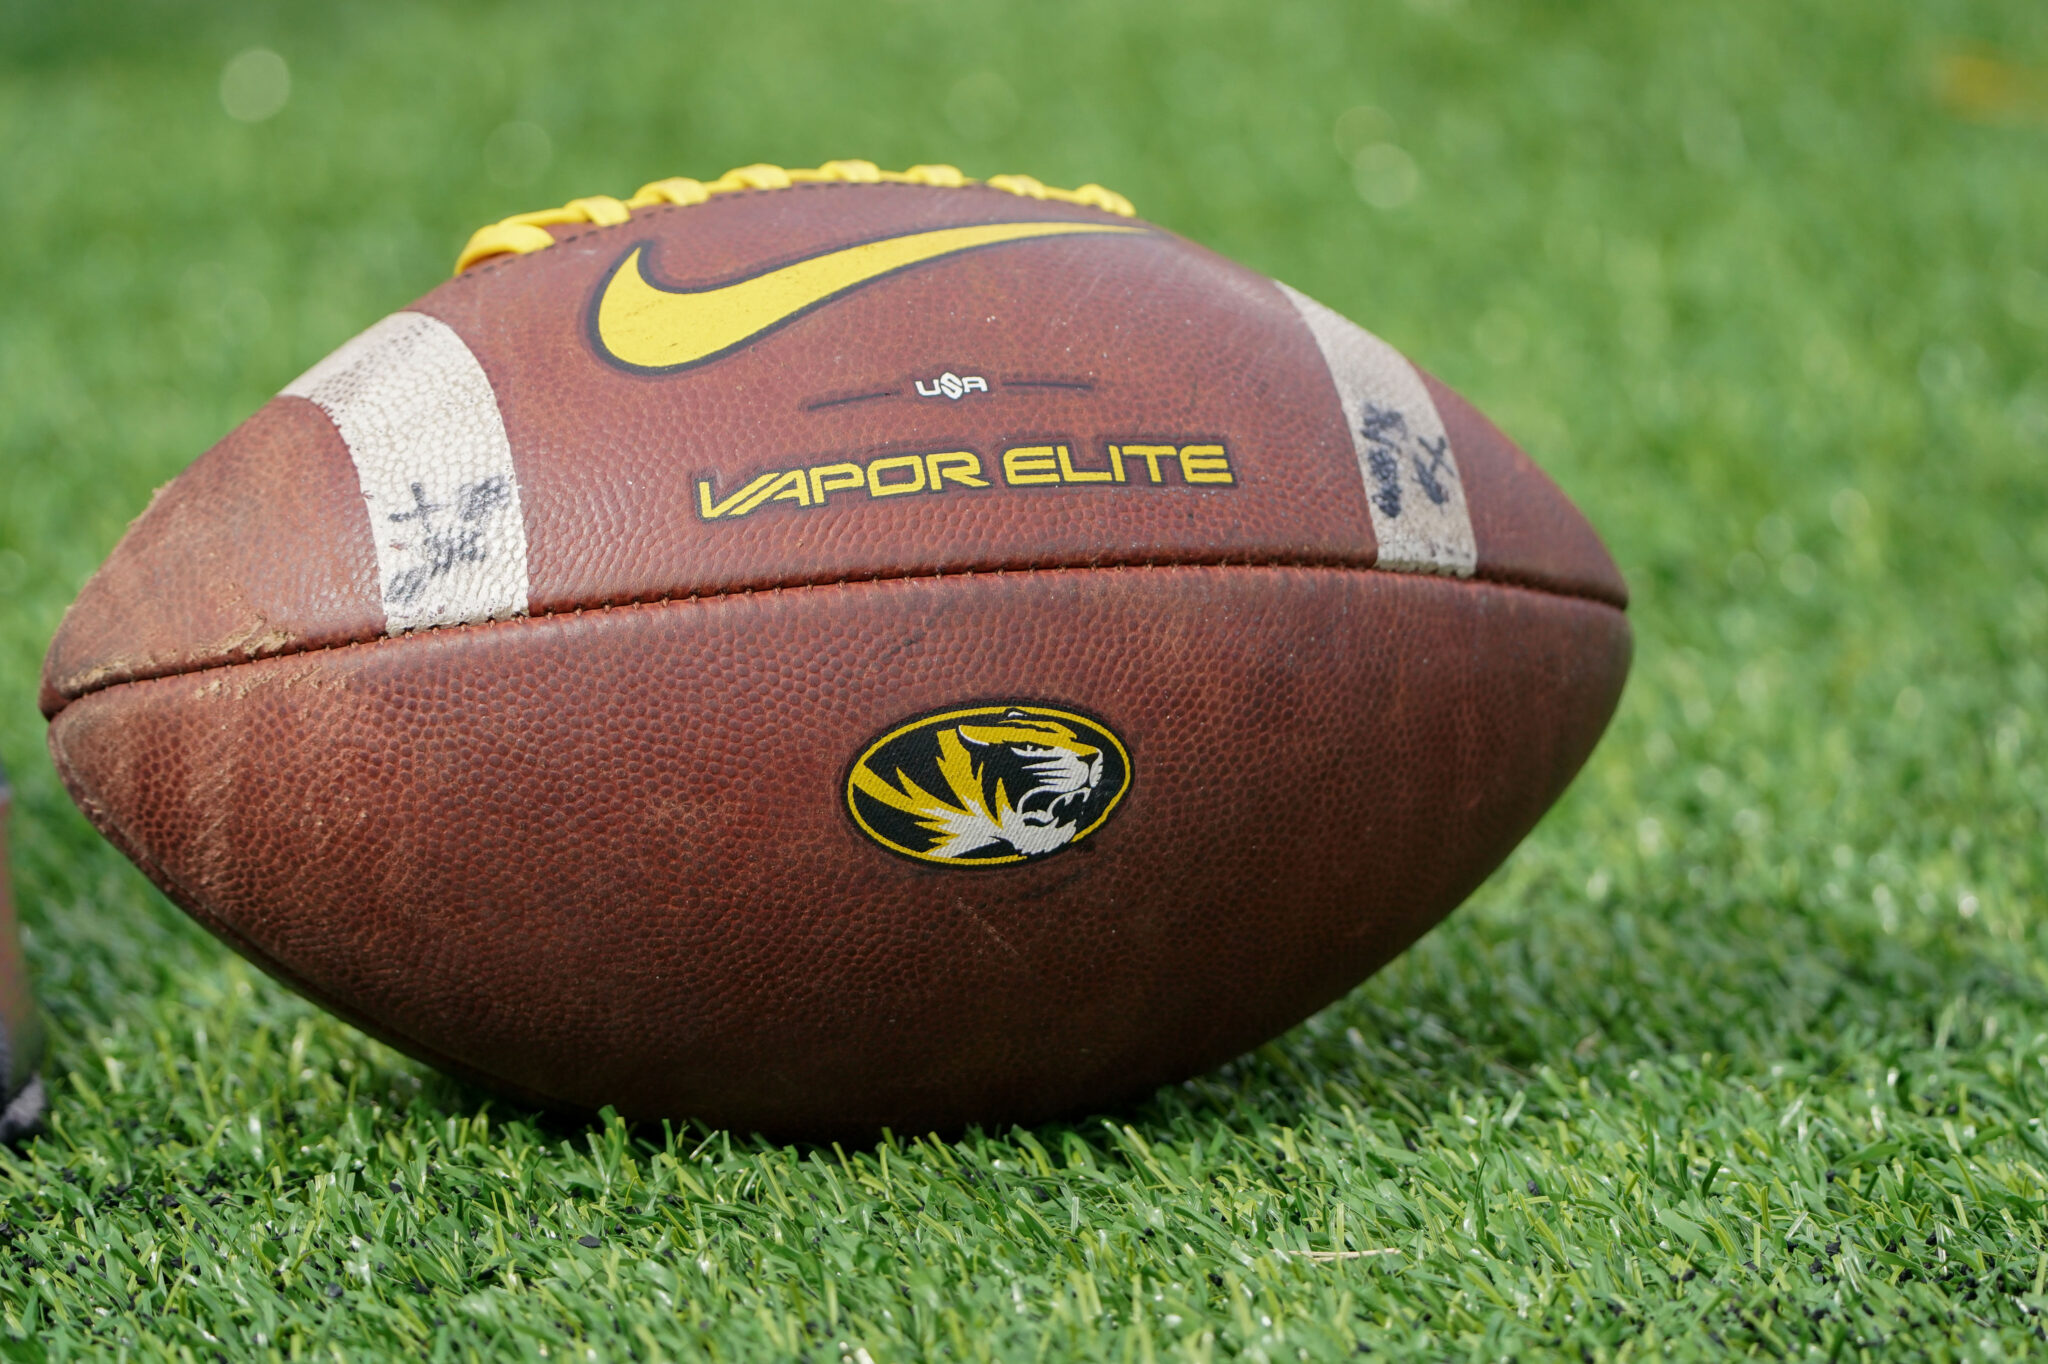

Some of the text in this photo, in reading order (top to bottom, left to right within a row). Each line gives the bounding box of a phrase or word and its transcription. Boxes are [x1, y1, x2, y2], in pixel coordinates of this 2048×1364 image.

[915, 371, 988, 400] USA
[699, 444, 1233, 518] VAPOR ELITE
